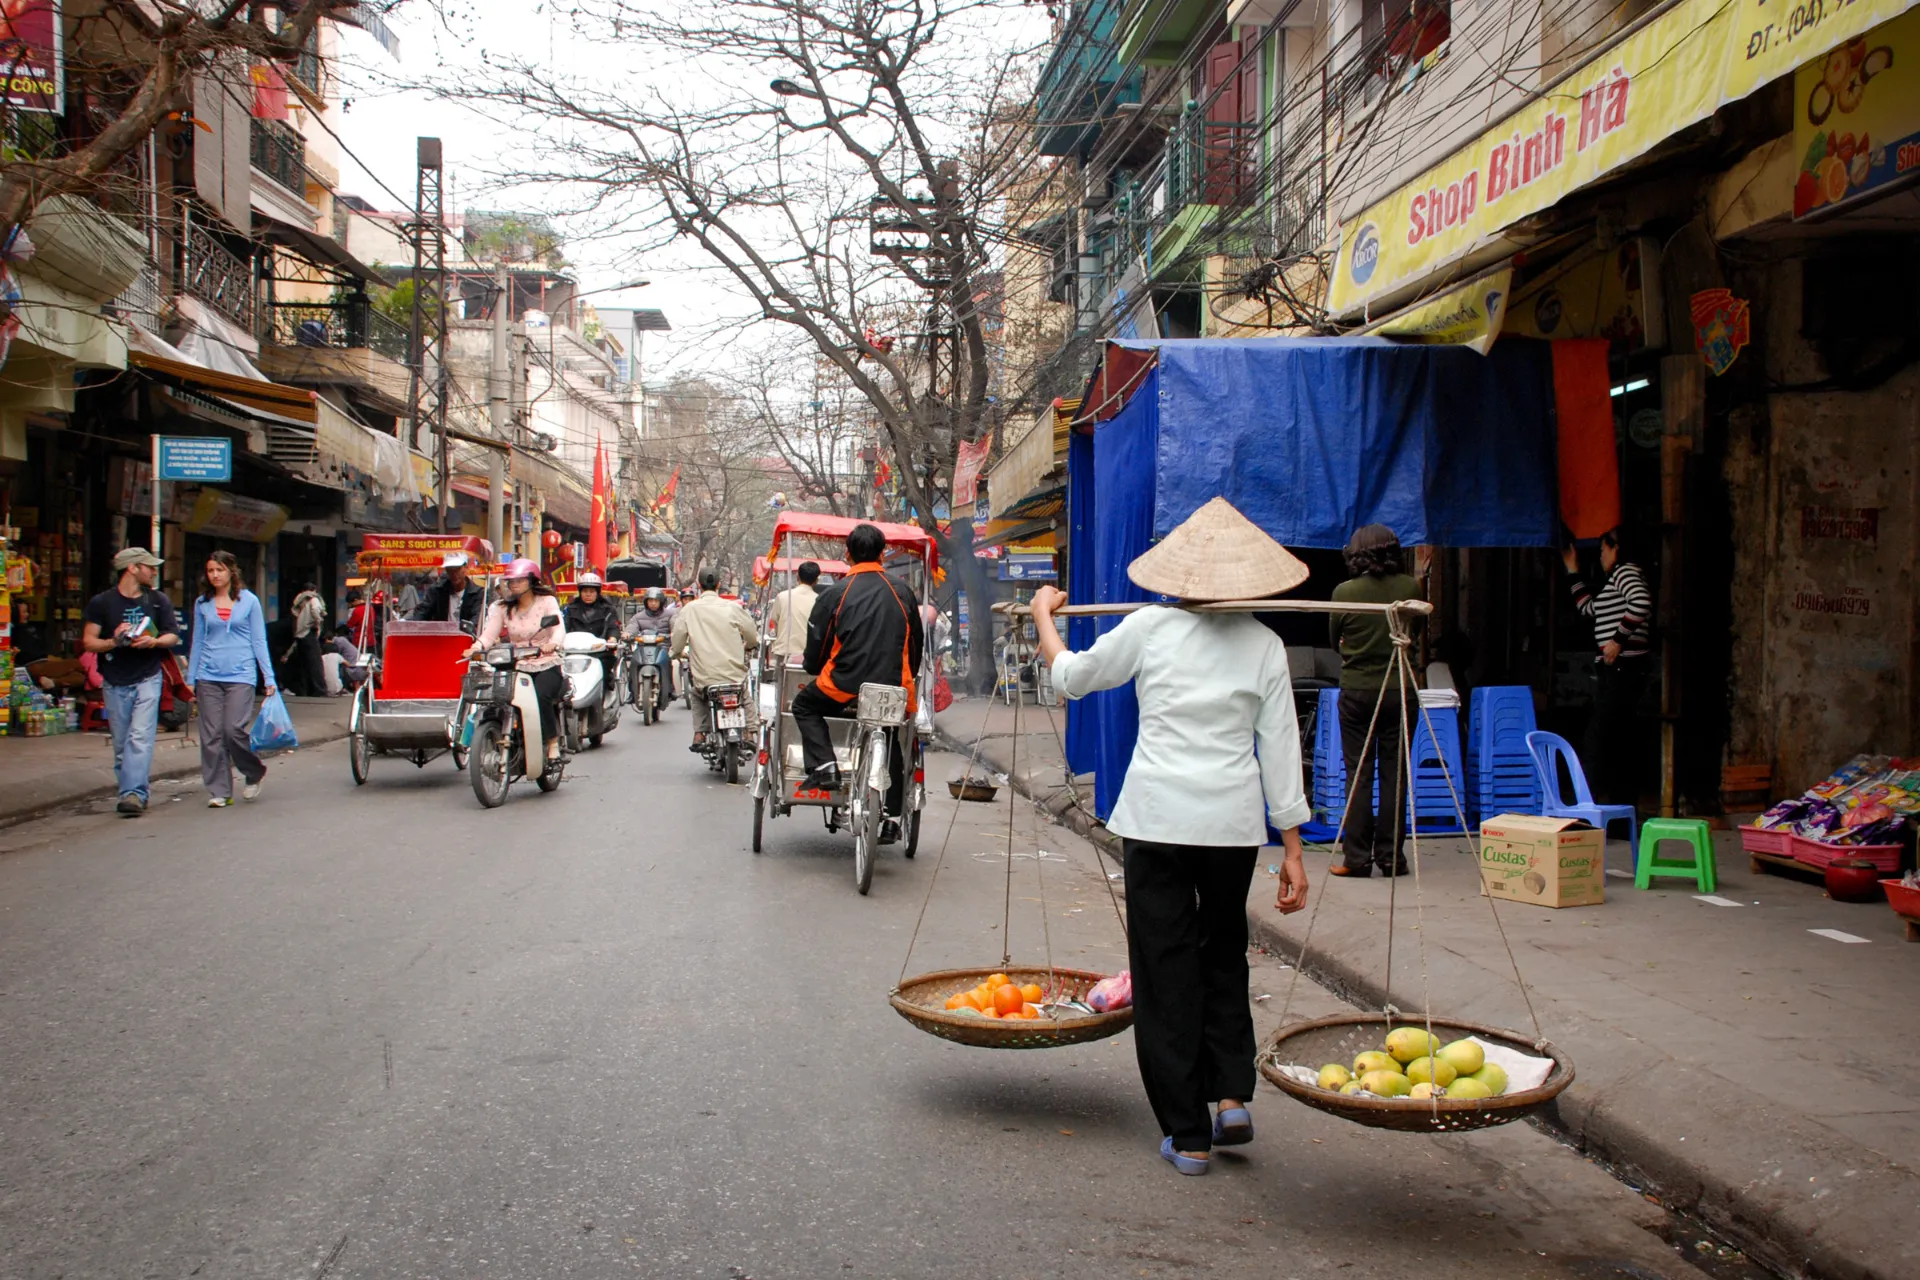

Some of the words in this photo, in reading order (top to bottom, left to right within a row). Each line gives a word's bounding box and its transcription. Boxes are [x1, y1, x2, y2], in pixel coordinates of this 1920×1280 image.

[1746, 23, 1773, 60] ĐT
[10, 76, 54, 95] CÔNG
[1407, 170, 1478, 246] Shop
[1577, 66, 1630, 152] Hà
[1352, 242, 1378, 271] ARCOR
[379, 539, 406, 549] SANS
[408, 539, 437, 549] SOUCI
[877, 691, 890, 704] 29
[1483, 846, 1527, 865] Custas
[1560, 857, 1590, 869] Custas
